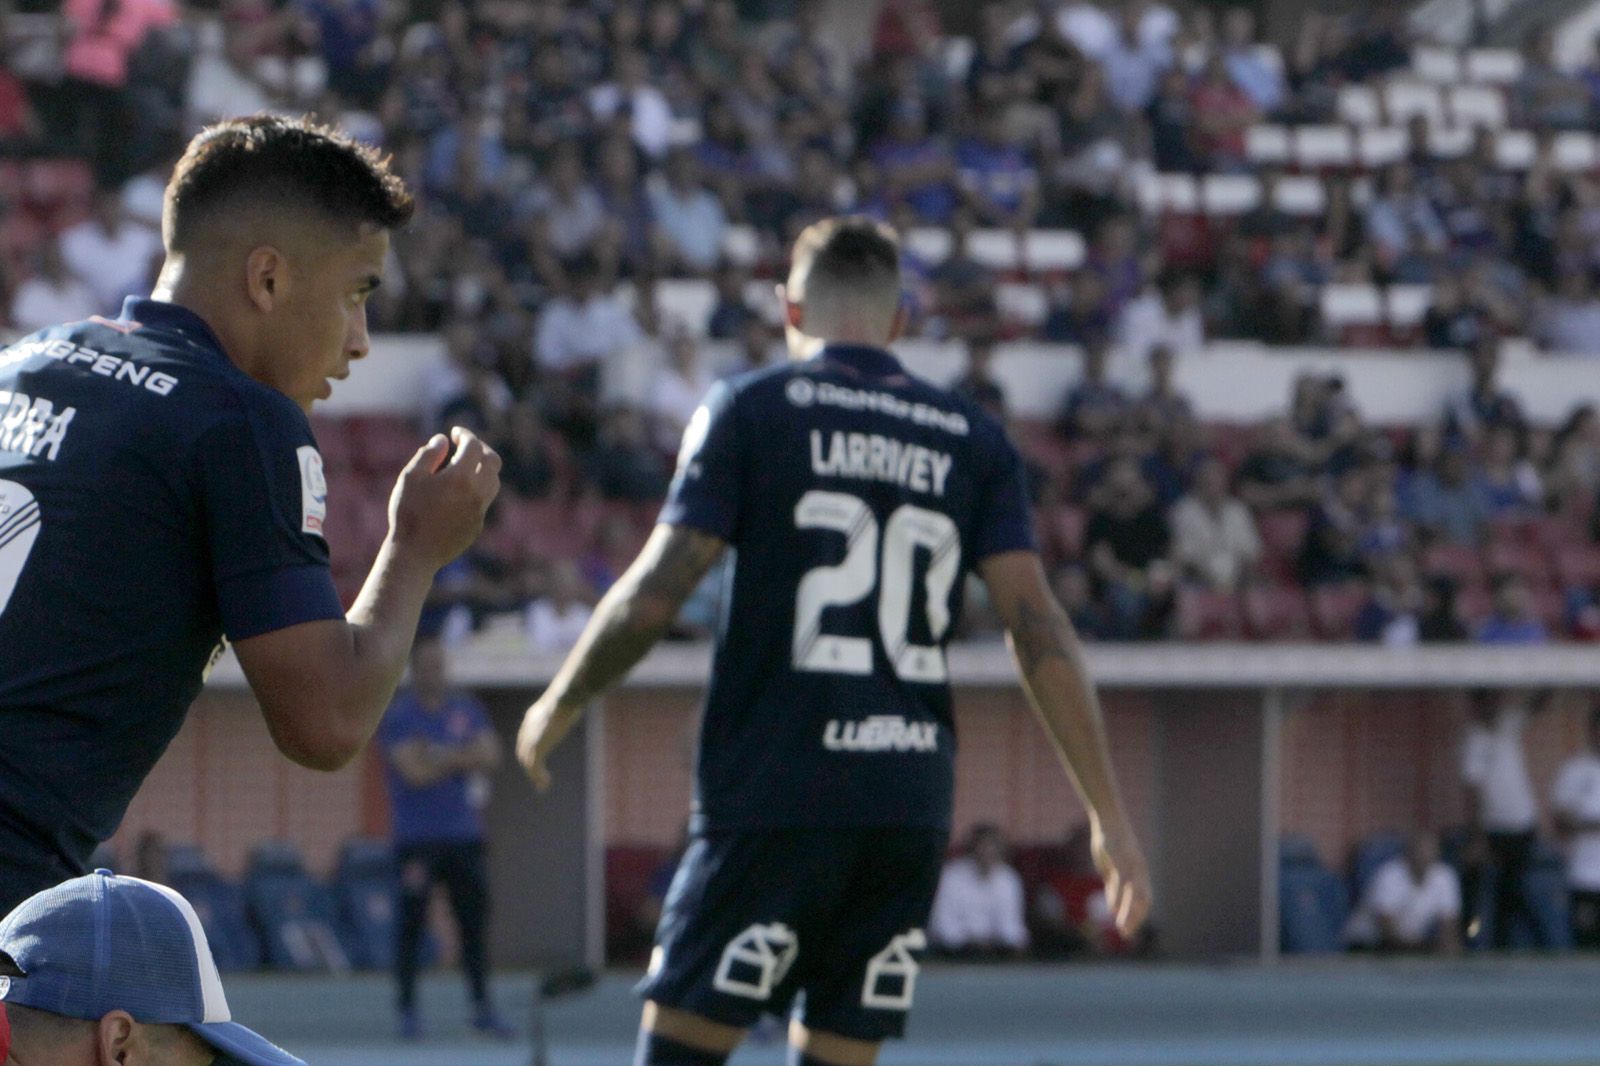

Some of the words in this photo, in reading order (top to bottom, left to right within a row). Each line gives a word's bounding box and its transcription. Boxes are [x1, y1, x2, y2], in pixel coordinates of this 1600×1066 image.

[809, 428, 953, 497] LARRIVEY
[791, 489, 962, 685] 20
[822, 714, 940, 755] LUBRAX
